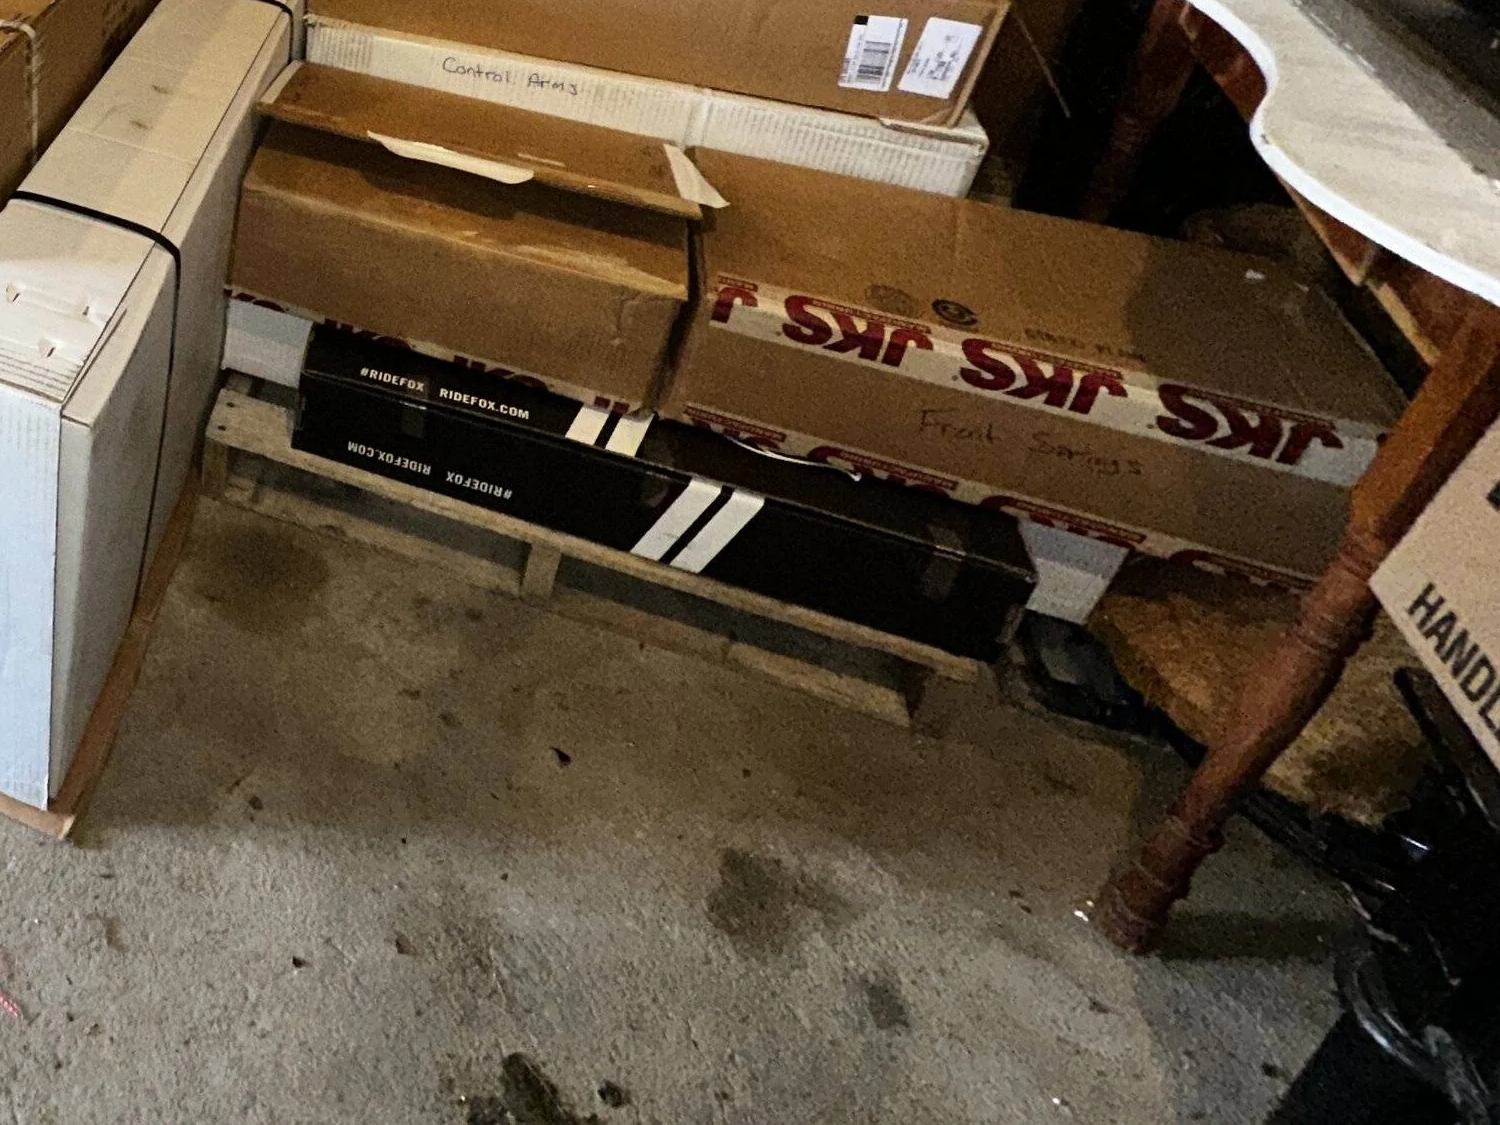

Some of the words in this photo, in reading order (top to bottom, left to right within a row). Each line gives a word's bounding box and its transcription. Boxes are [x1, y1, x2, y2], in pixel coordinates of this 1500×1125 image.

[442, 56, 511, 83] Control
[781, 294, 934, 367] JKS
[360, 367, 425, 392] #RIDEFOX
[439, 387, 530, 420] RIDEFOX.COM
[960, 338, 1129, 415] JKS
[1156, 383, 1344, 466] JKS
[347, 440, 432, 475] RIDEFOX.COM
[445, 471, 513, 500] #RIDEFOX
[1405, 581, 1500, 743] HANDL
